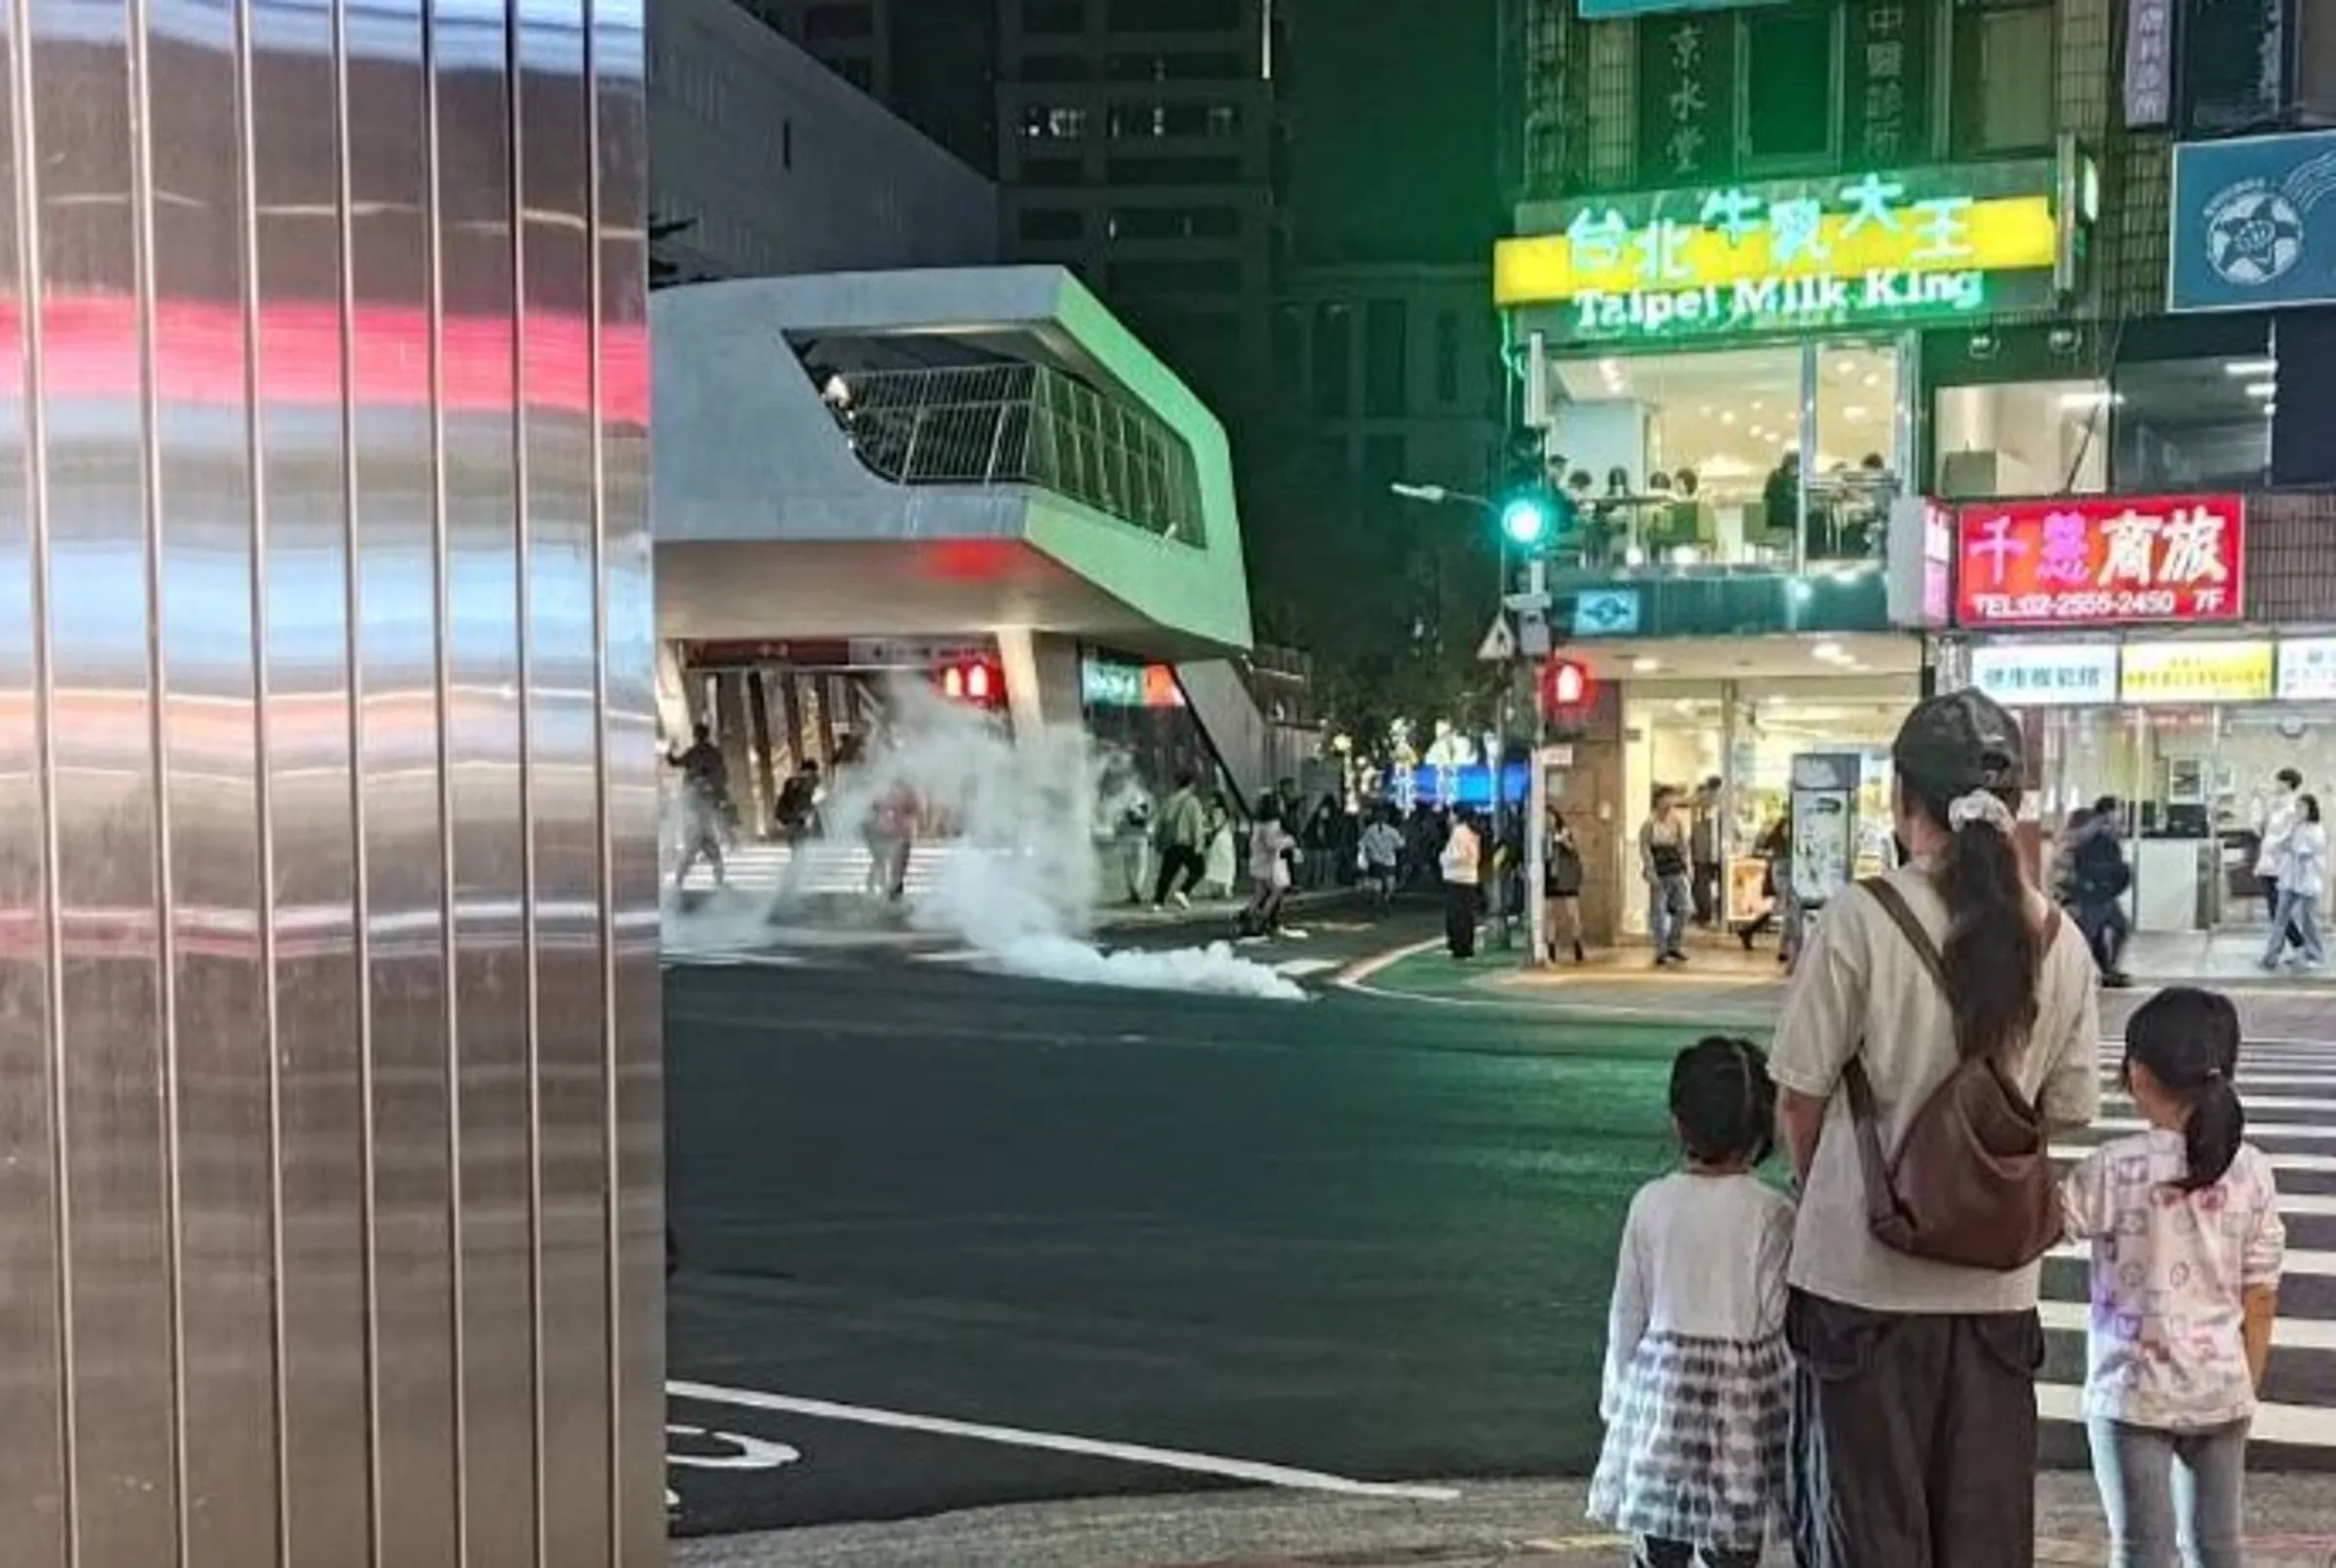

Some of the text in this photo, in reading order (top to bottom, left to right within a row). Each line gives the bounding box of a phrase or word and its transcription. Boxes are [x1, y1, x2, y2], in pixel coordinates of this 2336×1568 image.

[1566, 172, 1974, 281] 台北牛乳大王
[1572, 268, 1984, 332] Taipei Milk King
